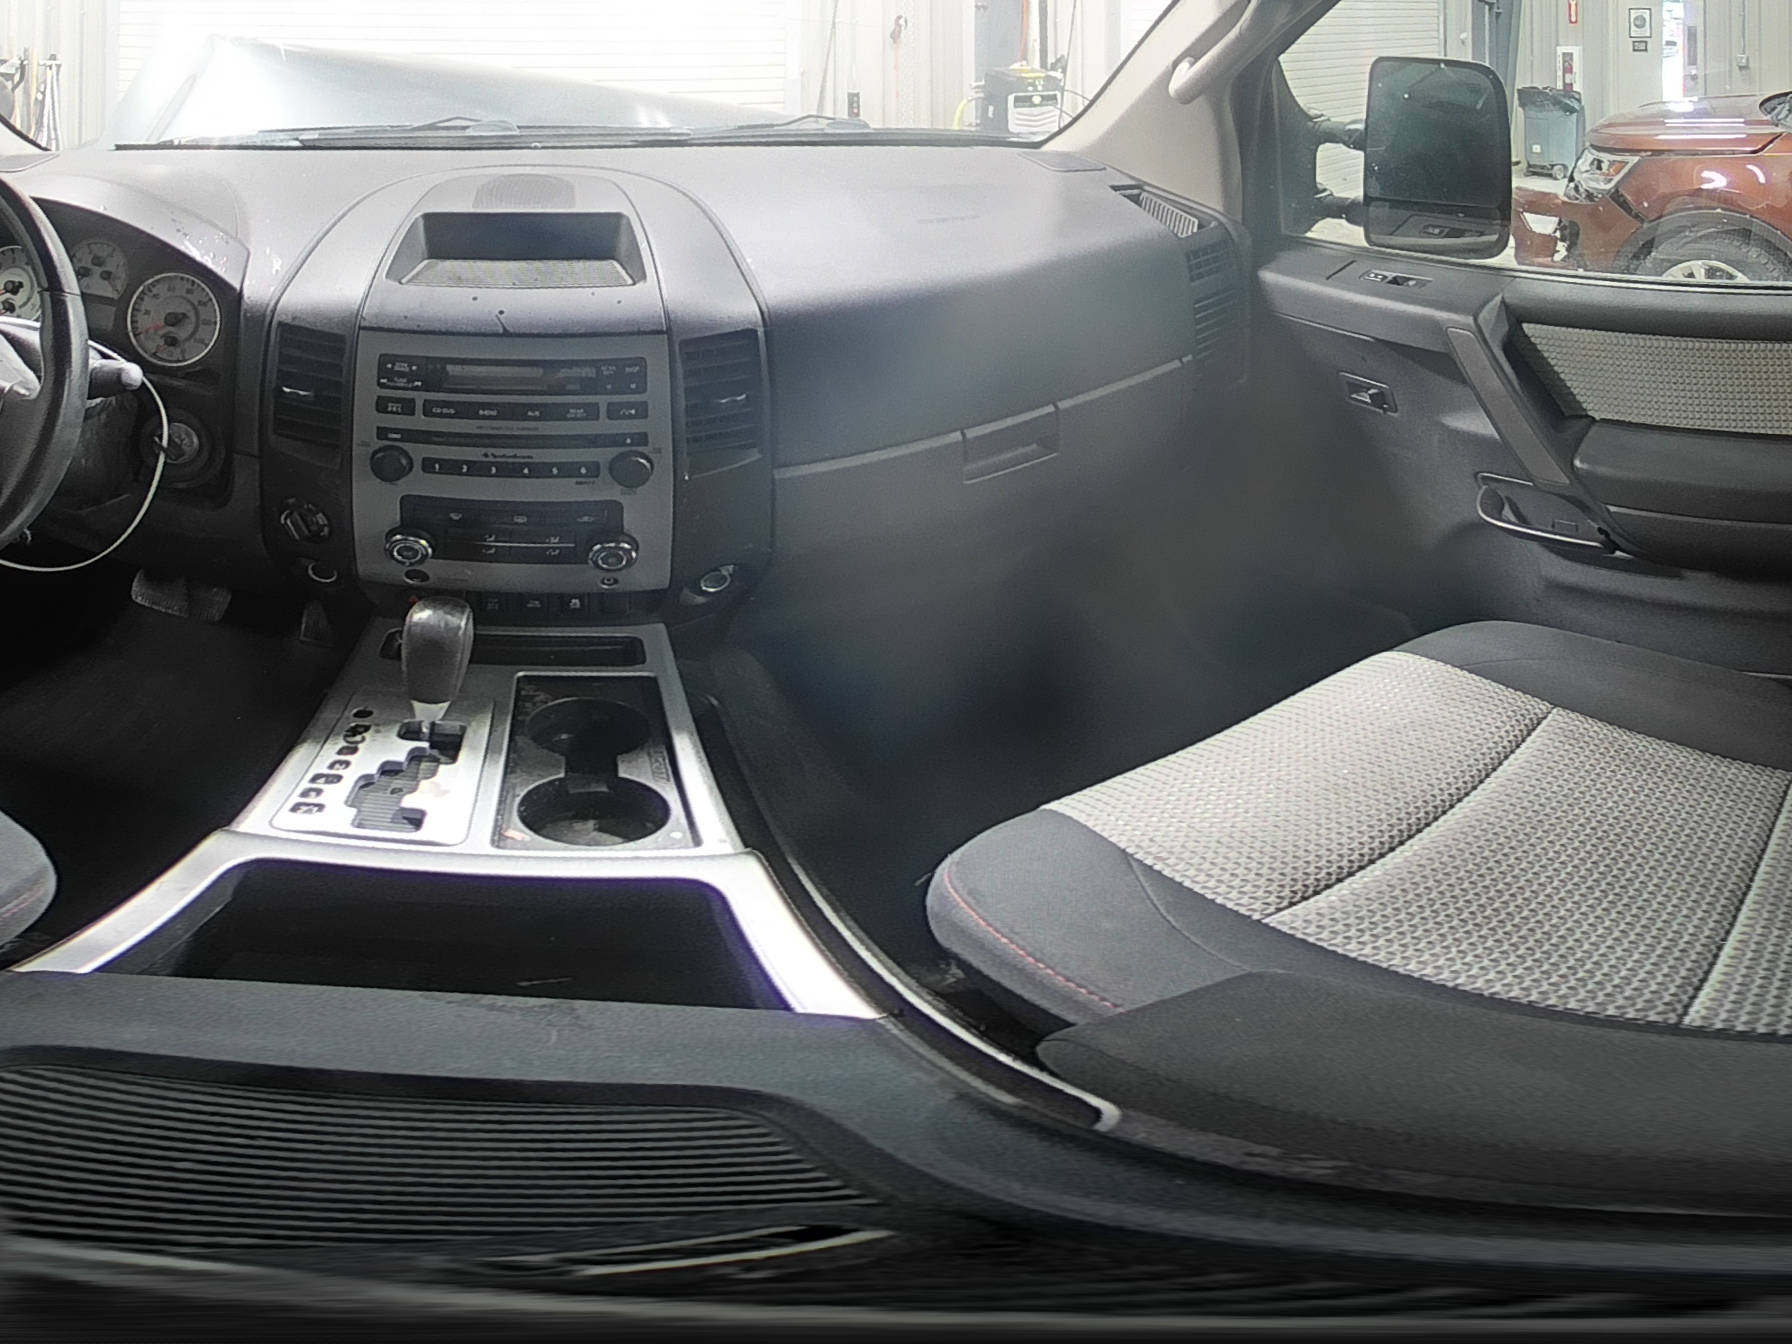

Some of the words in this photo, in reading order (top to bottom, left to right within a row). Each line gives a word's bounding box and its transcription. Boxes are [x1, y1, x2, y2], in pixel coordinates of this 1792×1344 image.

[434, 462, 440, 473] 1
[461, 463, 468, 474] 2
[490, 465, 497, 475] 3
[522, 466, 530, 475] 4
[552, 466, 559, 475] 5
[580, 465, 587, 475] 6
